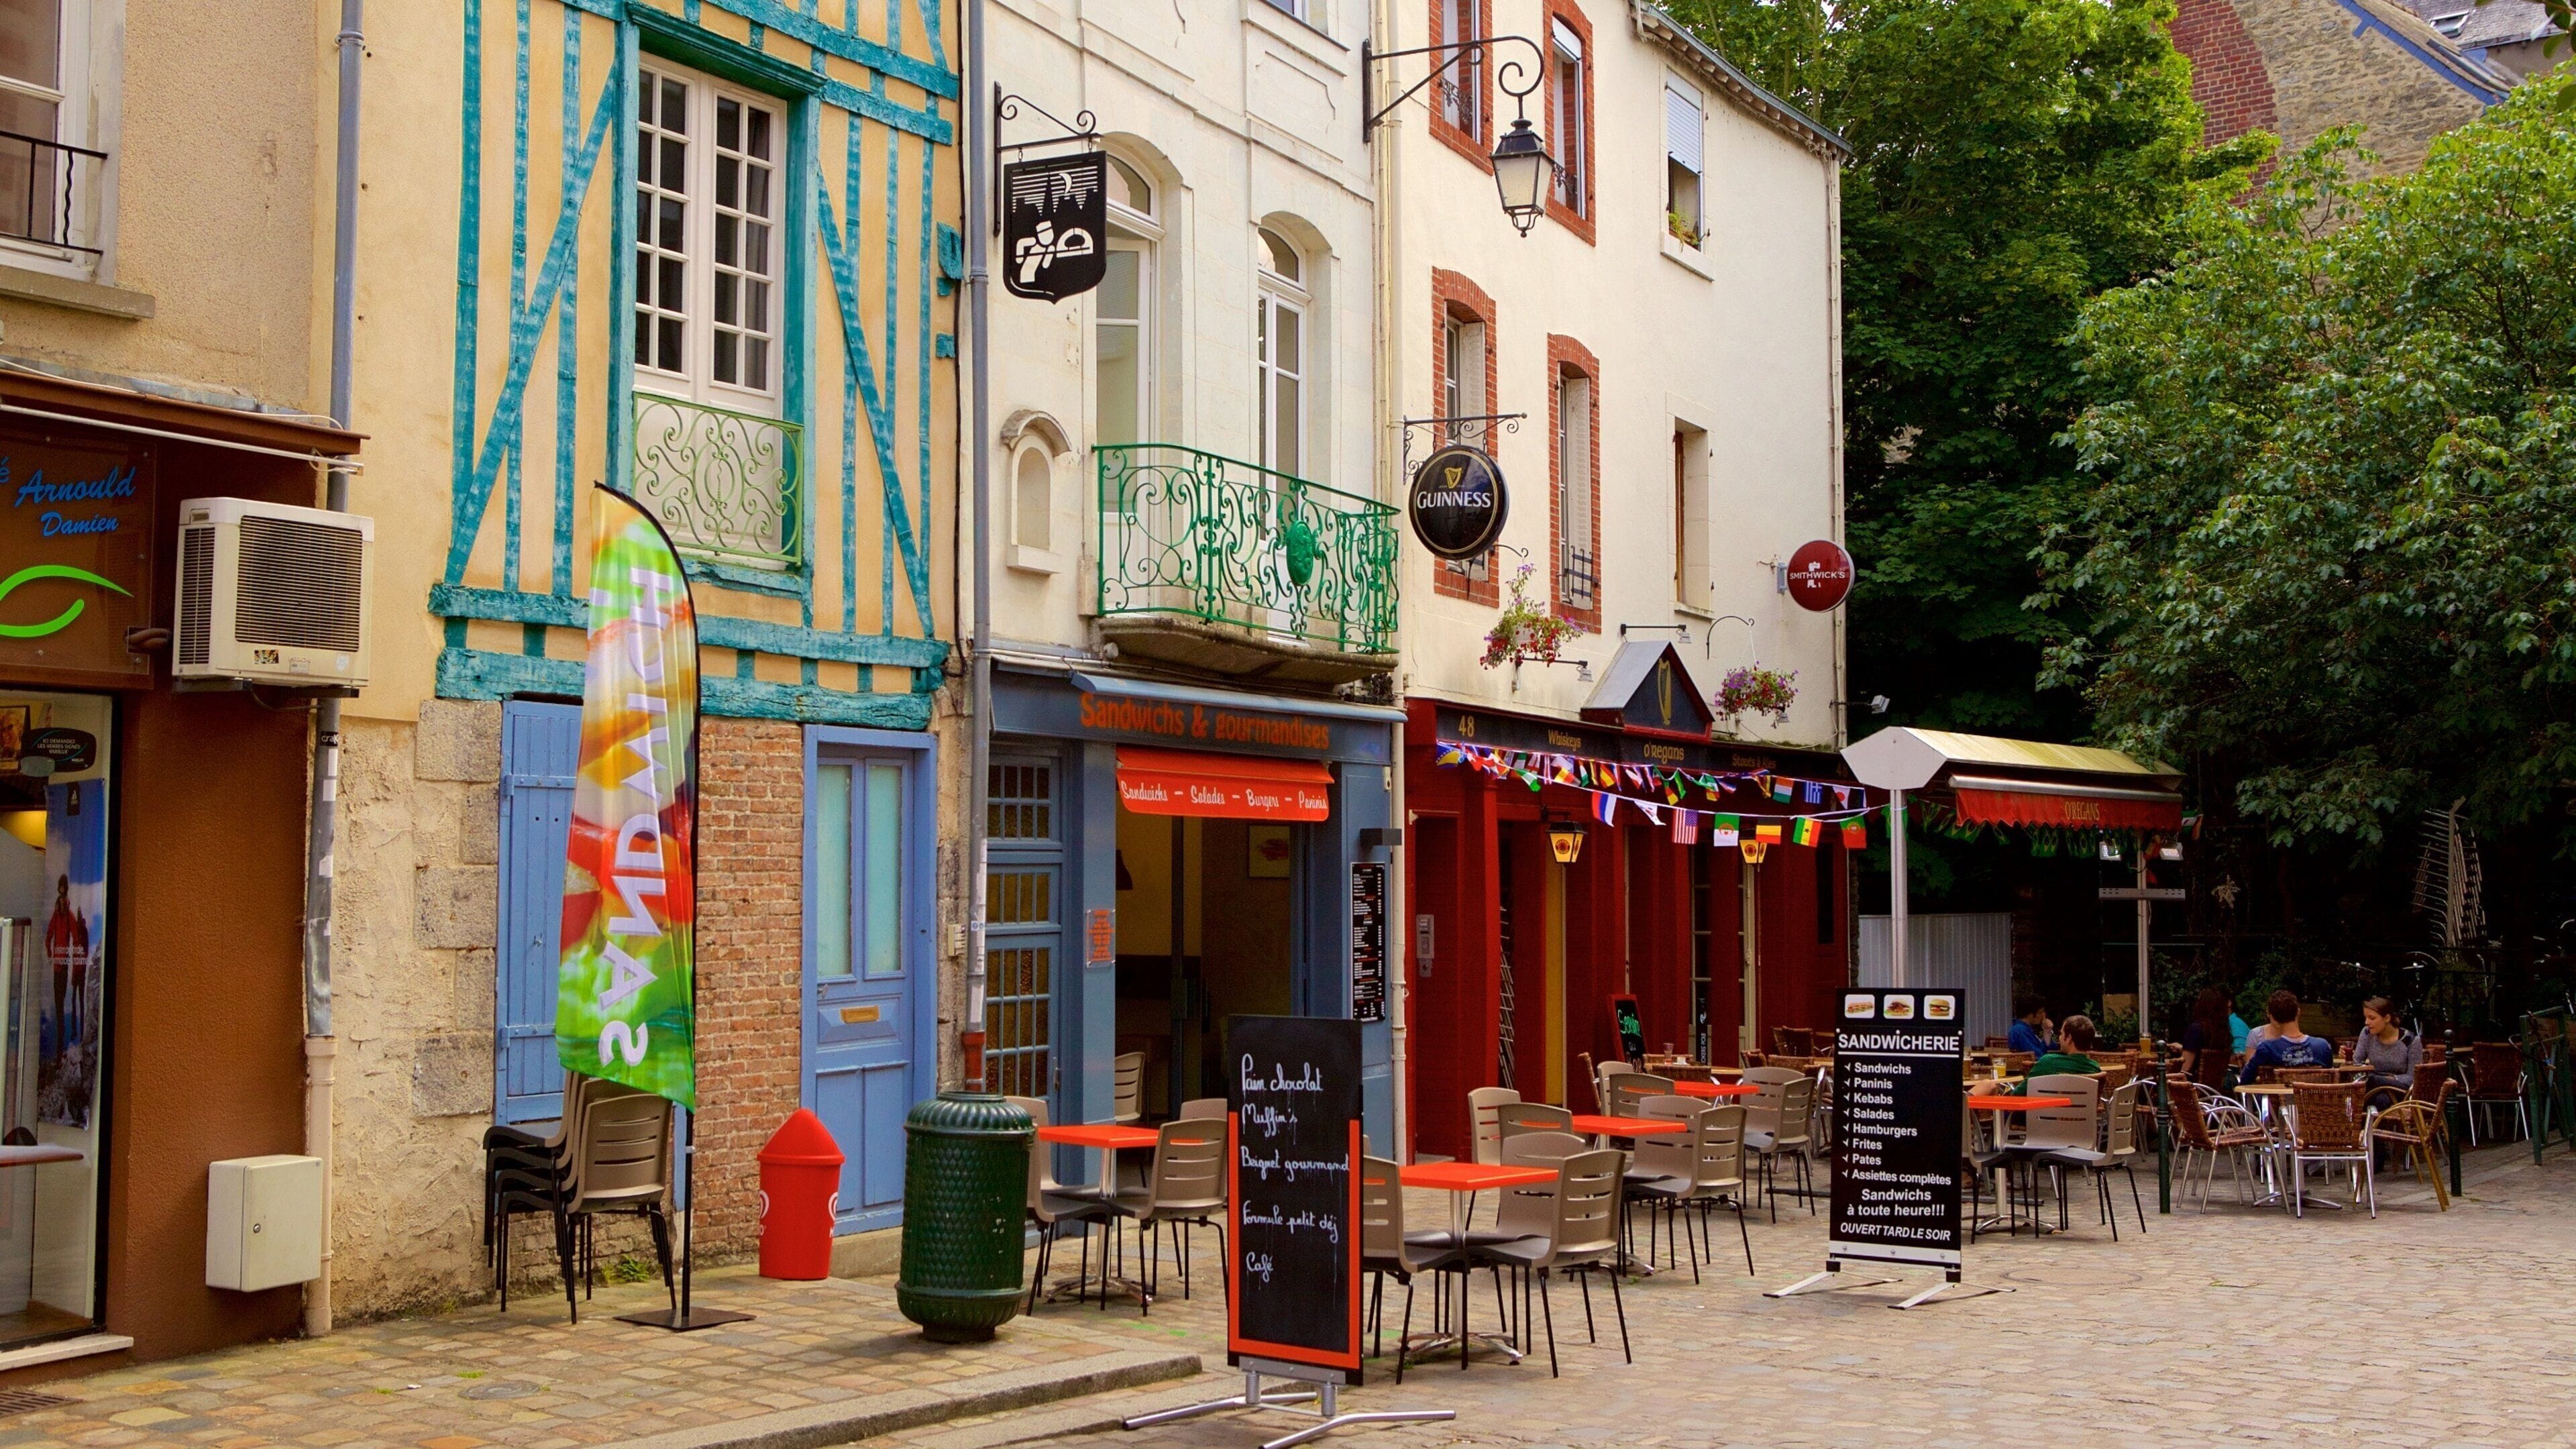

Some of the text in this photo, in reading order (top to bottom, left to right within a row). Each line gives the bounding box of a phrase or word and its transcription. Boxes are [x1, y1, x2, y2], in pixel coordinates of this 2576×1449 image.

[13, 466, 136, 507] Arnould
[1417, 491, 1491, 509] GUINNESS
[41, 511, 118, 536] Damien
[1790, 572, 1845, 580] SMITHWICK'S
[1080, 692, 1330, 749] Sandwichs & gourmandises
[1458, 715, 1474, 737] 48
[1548, 729, 1581, 751] Whiskeys
[1121, 782, 1168, 801] Sandwichs
[1191, 786, 1225, 805] Salades
[1246, 789, 1279, 812] Burgers
[1299, 791, 1327, 810] Paninis
[1838, 1034, 1960, 1051] SANDWICHERIE
[1242, 1053, 1324, 1092] Pain chocolat
[1854, 1062, 1911, 1074] Sandwichs
[1854, 1077, 1892, 1089] Paninis
[1854, 1092, 1893, 1104] Kebabs
[1853, 1108, 1894, 1120] Salades
[1853, 1123, 1918, 1138] Hamburgers
[1853, 1138, 1882, 1150] Frites
[1240, 1146, 1350, 1182] Beignet gourmand
[1852, 1154, 1881, 1165] Pates
[1851, 1169, 1951, 1185] Assiettes complètes
[1862, 1188, 1931, 1201] Sandwichs
[1243, 1200, 1283, 1225] Formule
[1286, 1210, 1315, 1234] petit
[1847, 1203, 1945, 1216] à toute heure!!!
[1840, 1222, 1951, 1241] OUVERT TARD LE SOIR
[1246, 1252, 1273, 1282] Café
